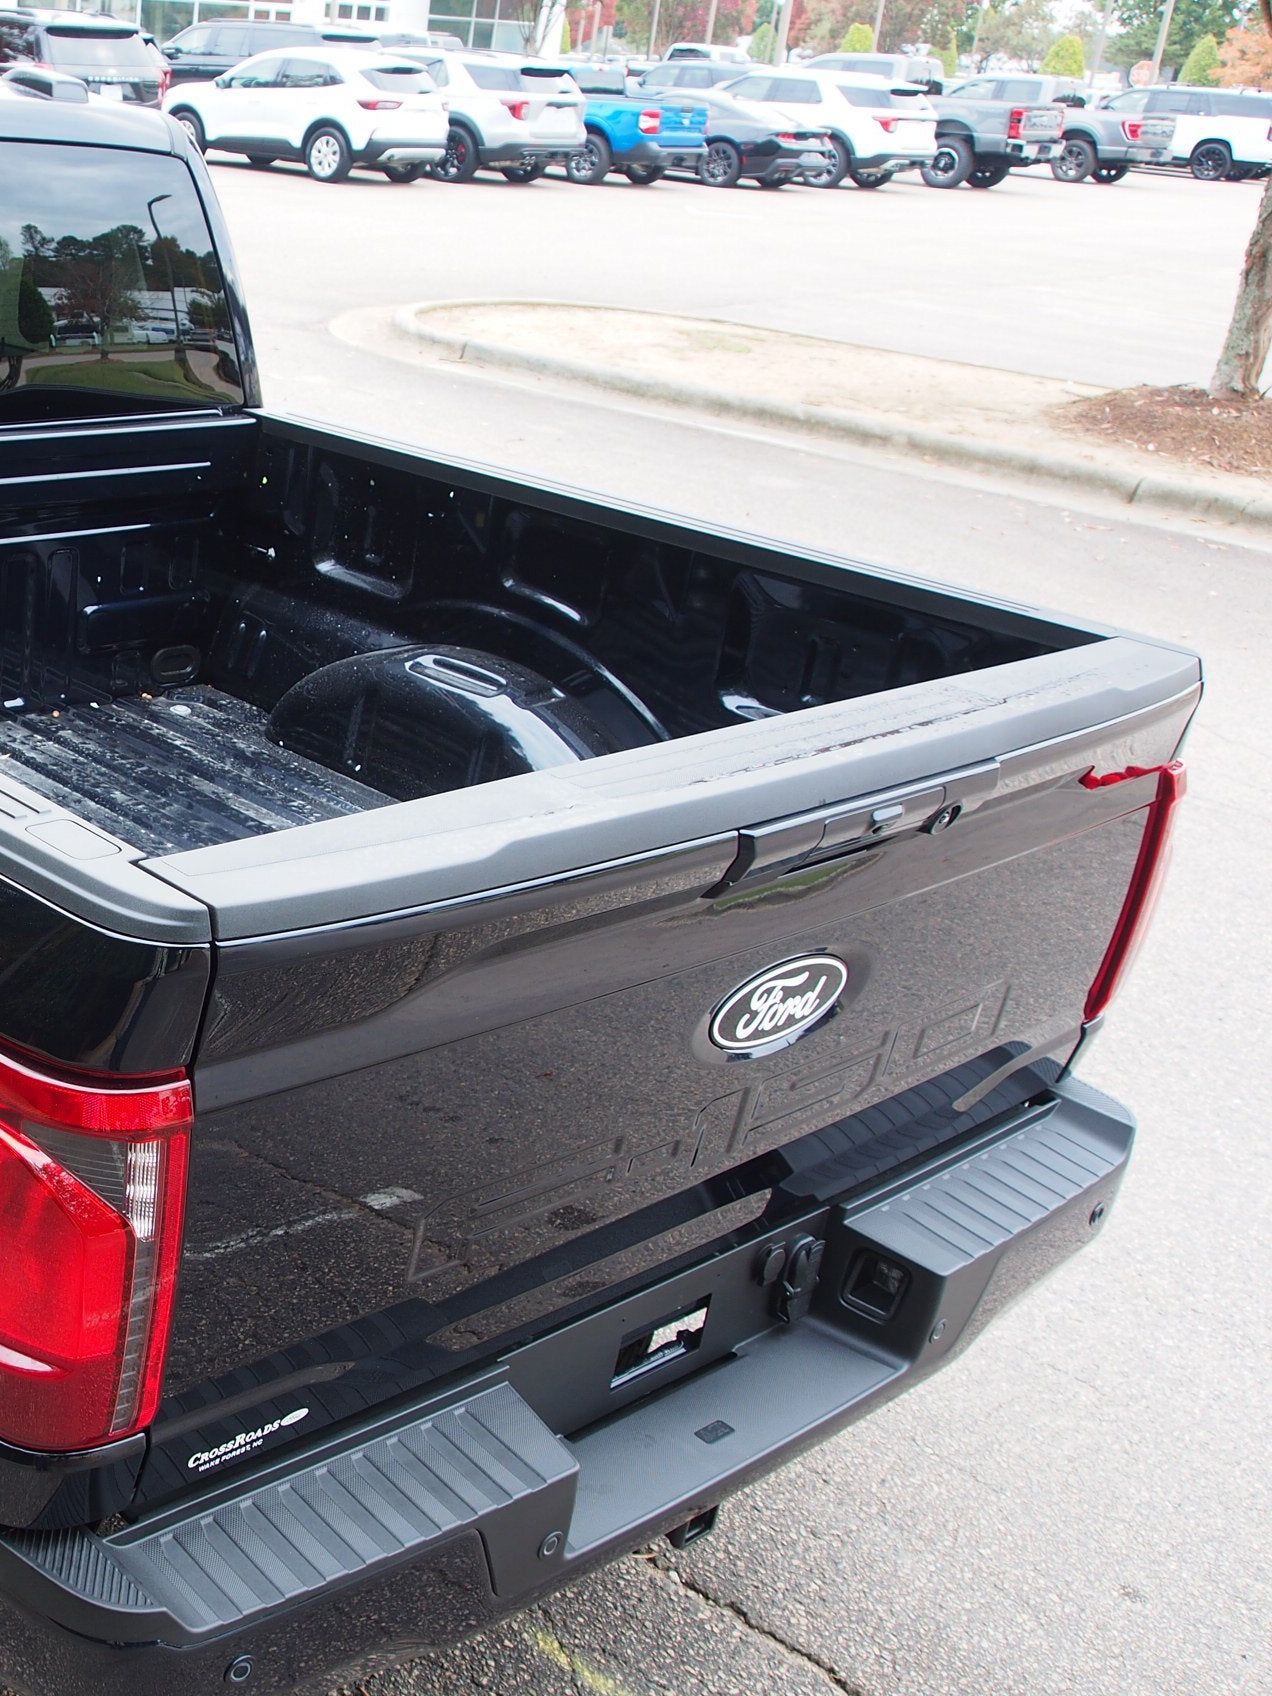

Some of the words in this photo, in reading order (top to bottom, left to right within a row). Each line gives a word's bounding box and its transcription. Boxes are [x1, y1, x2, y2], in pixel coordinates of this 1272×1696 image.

[735, 971, 828, 1040] Ford
[198, 1458, 221, 1472] WAKE
[252, 1438, 264, 1449] NC
